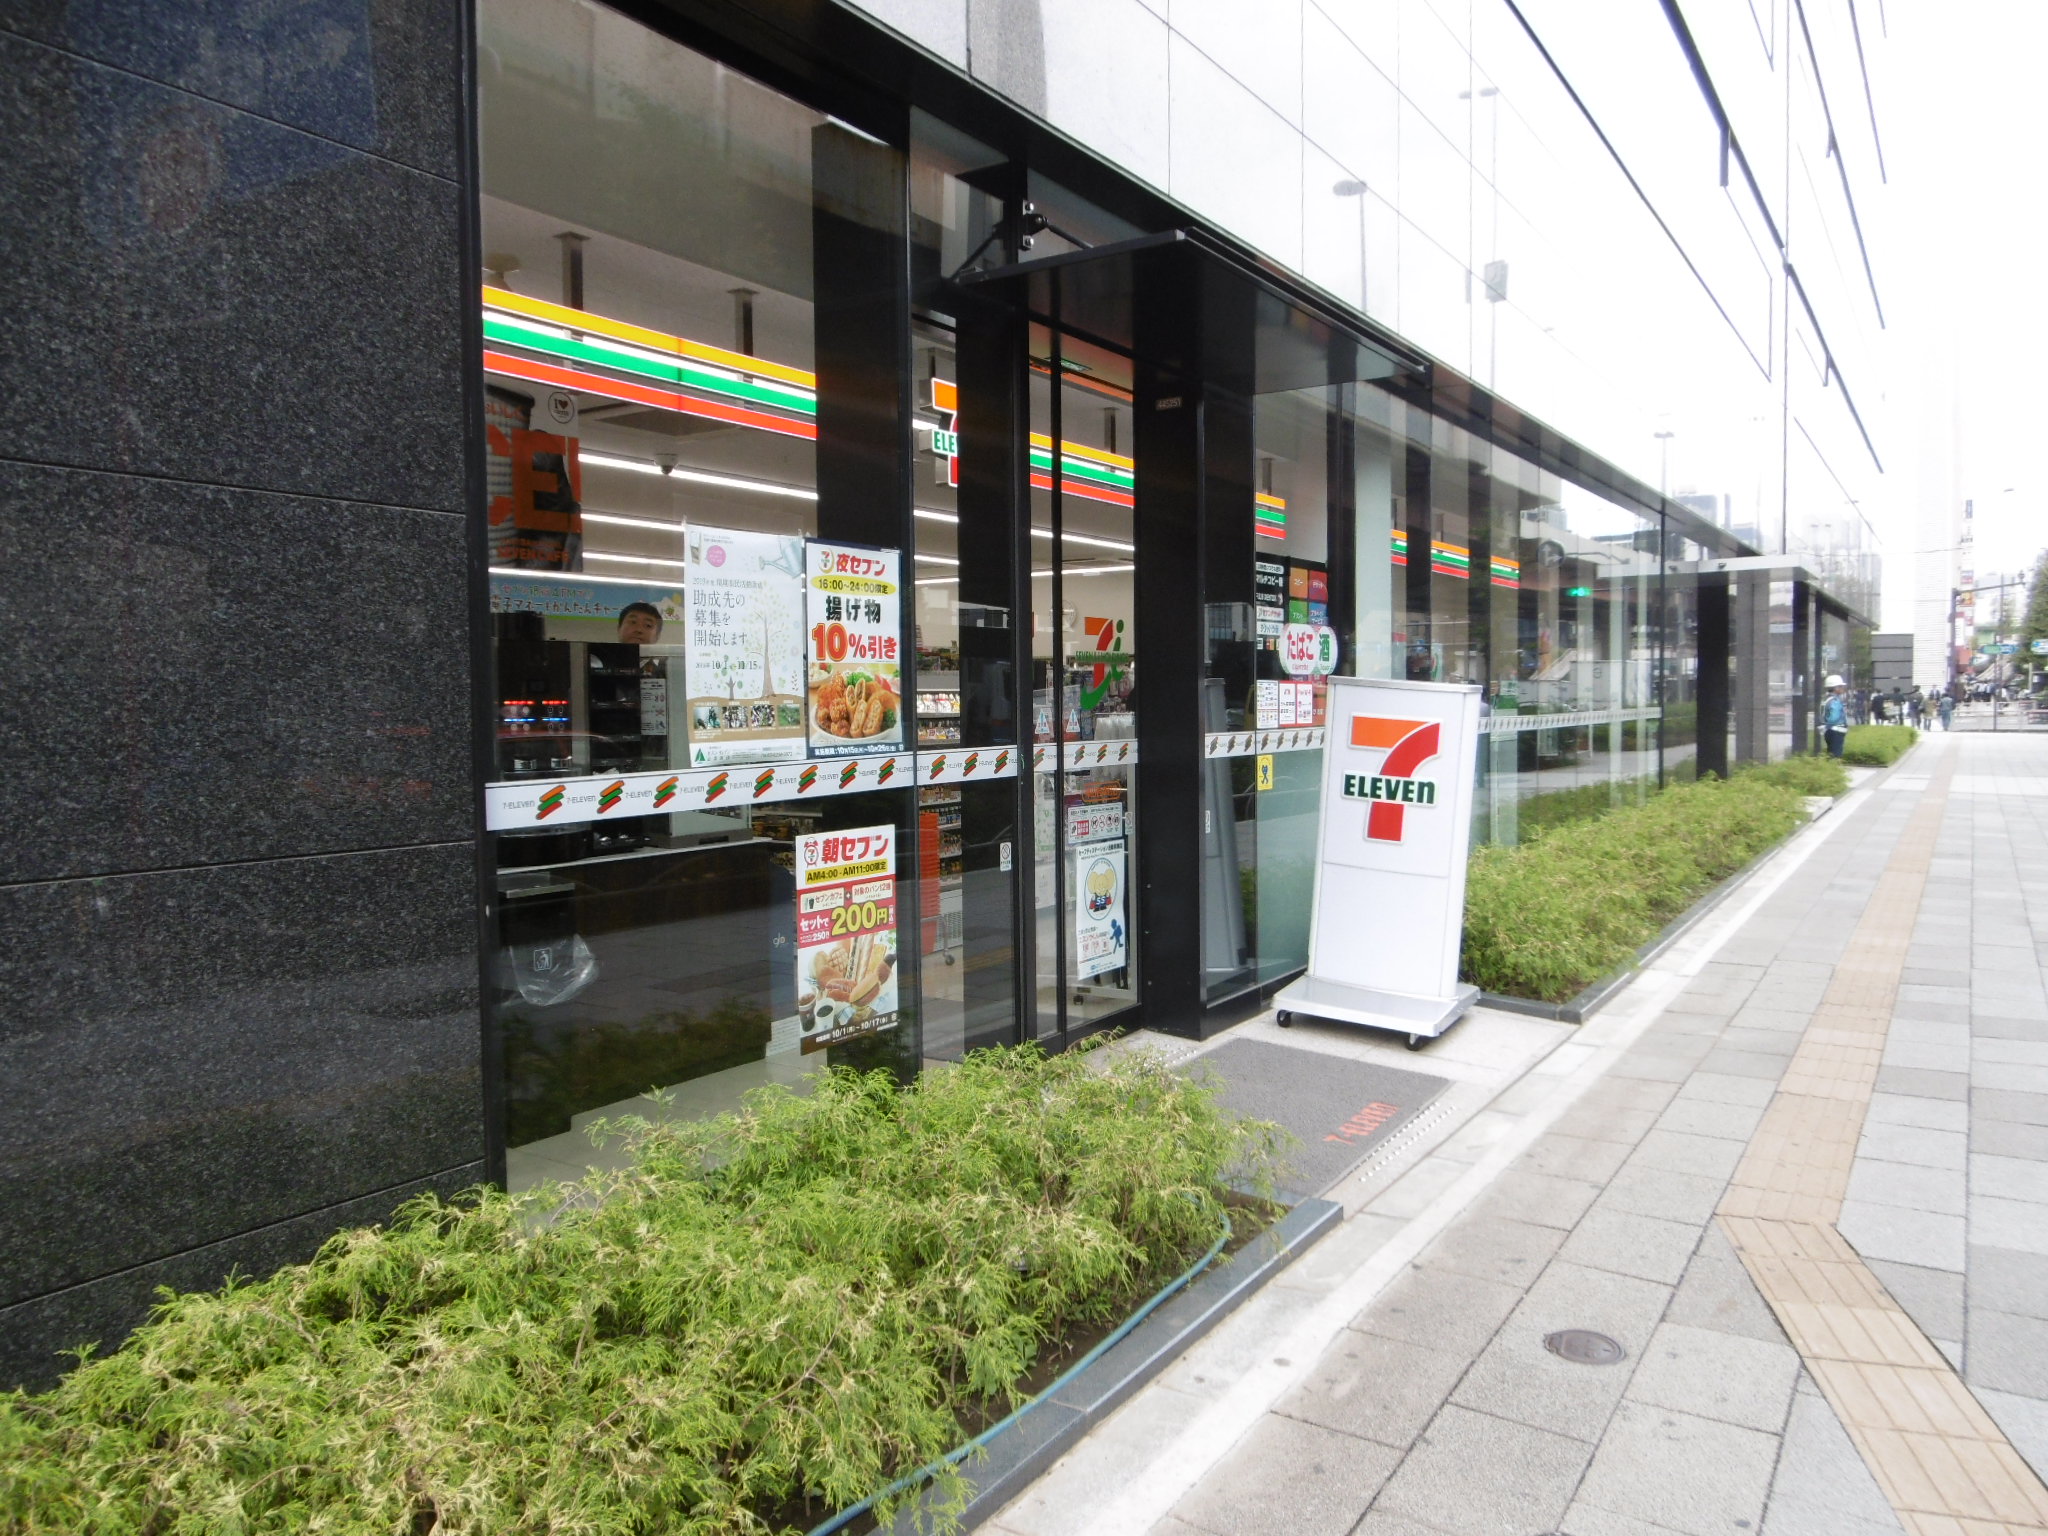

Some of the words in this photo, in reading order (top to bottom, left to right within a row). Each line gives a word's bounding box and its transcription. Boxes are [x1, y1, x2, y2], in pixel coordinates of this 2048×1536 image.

[933, 431, 957, 454] ELE
[835, 552, 887, 576] 夜セブン
[692, 589, 746, 609] 助成先の
[825, 595, 882, 624] 揚げ物
[693, 609, 731, 628] 募集を
[693, 629, 748, 648] 開始します
[811, 622, 898, 662] 10%引き
[1286, 630, 1315, 661] たばこ
[821, 834, 890, 865] 朝セブン
[1095, 896, 1107, 906] SS
[799, 914, 830, 932] セットで
[831, 900, 888, 937] 200円
